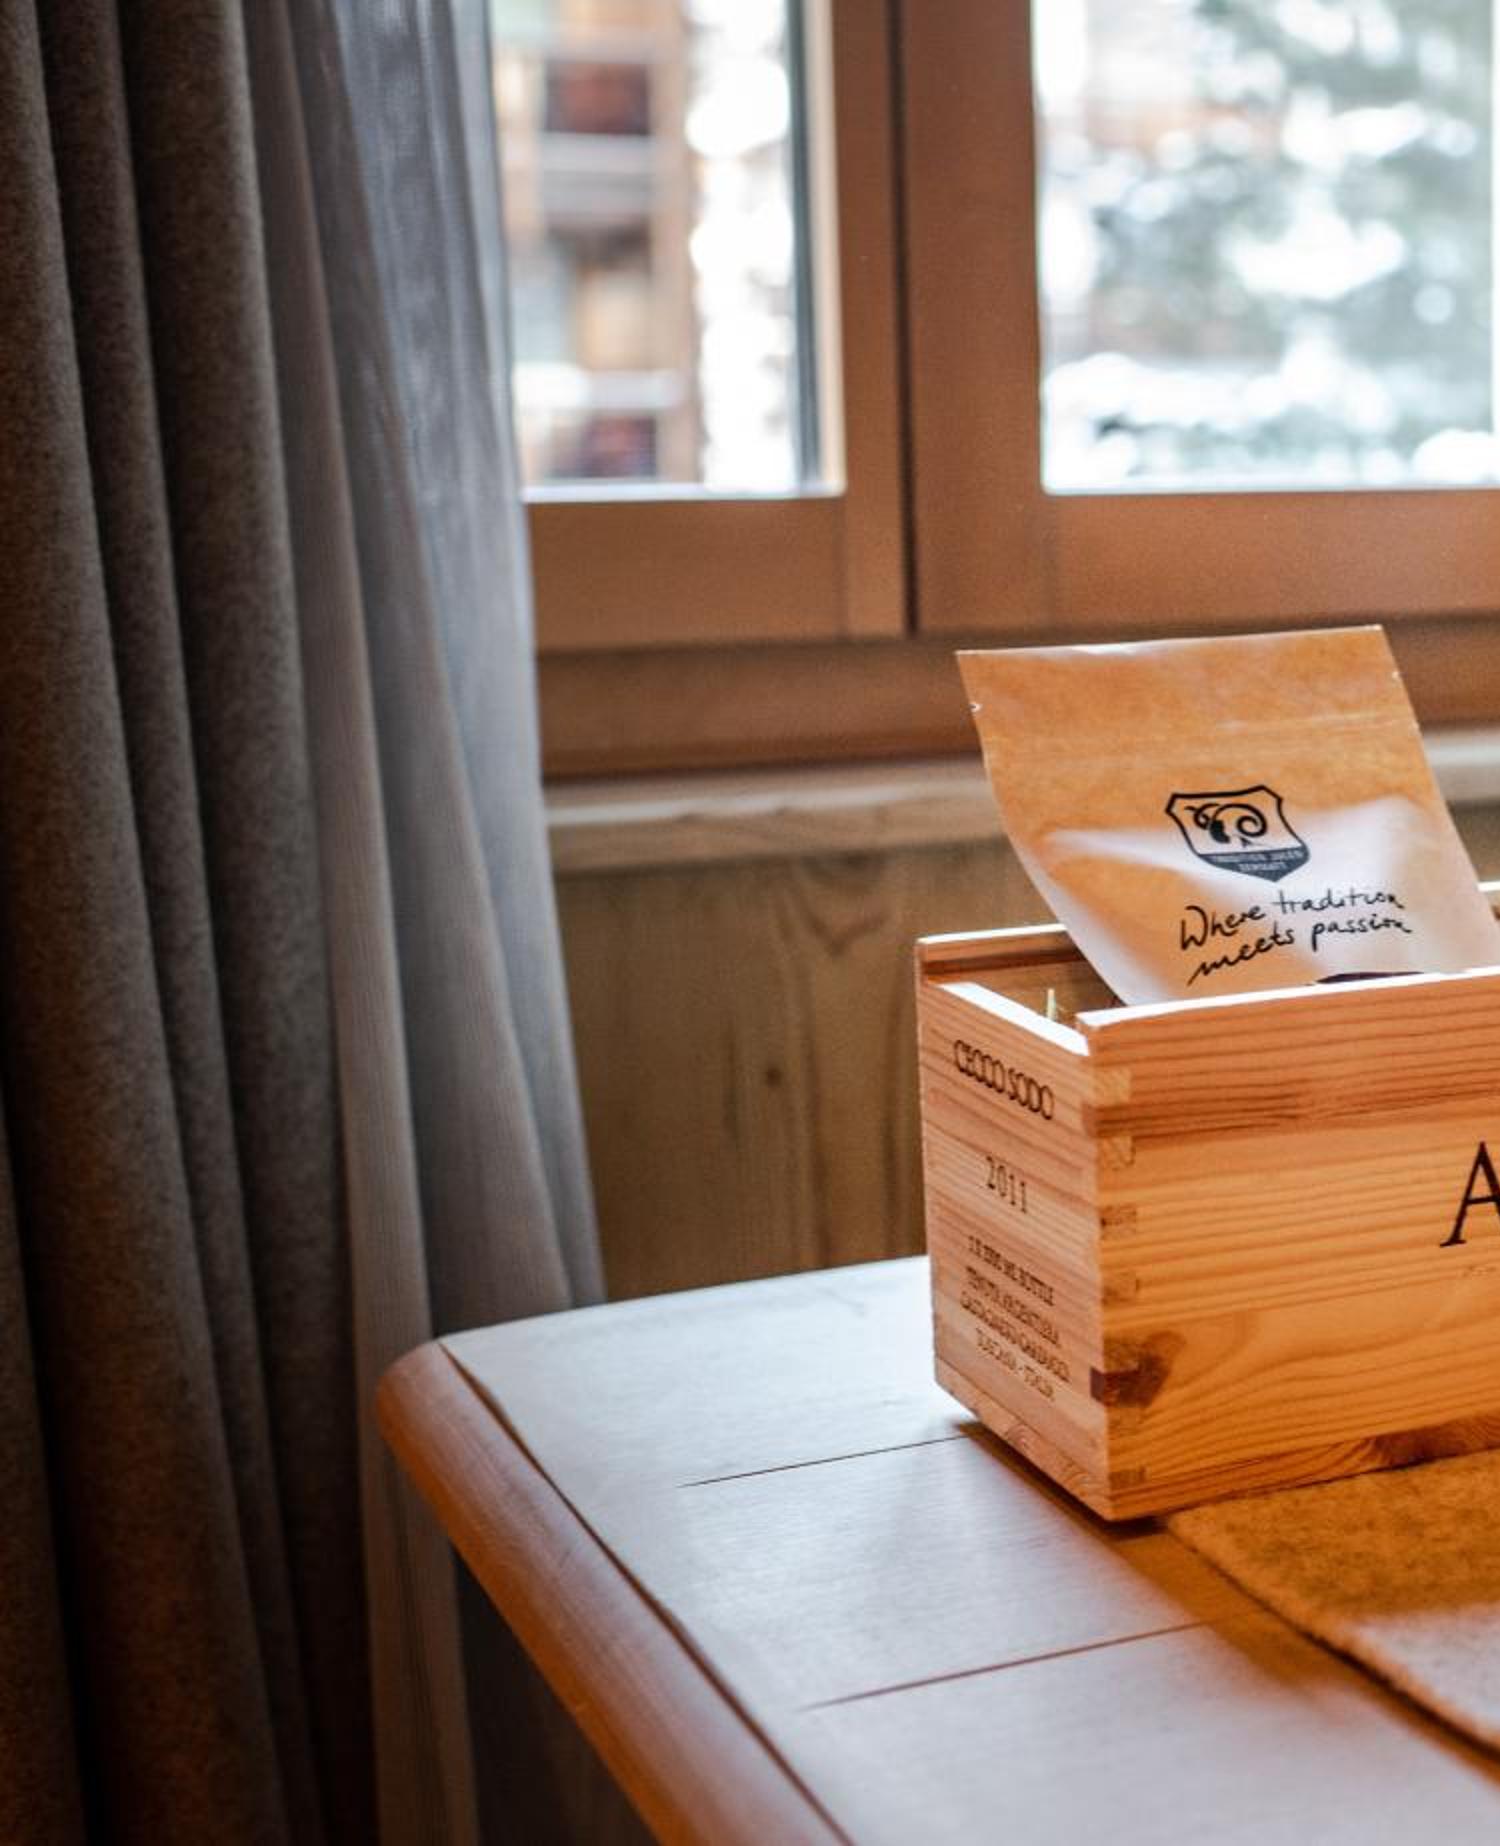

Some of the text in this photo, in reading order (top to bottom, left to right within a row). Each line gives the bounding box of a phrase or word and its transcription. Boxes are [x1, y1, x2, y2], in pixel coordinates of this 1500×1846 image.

[1180, 888, 1405, 950] Where tradition
[1187, 913, 1413, 987] meets passion
[954, 1039, 1055, 1121] CECCO SODO
[985, 1155, 1027, 1214] 2011
